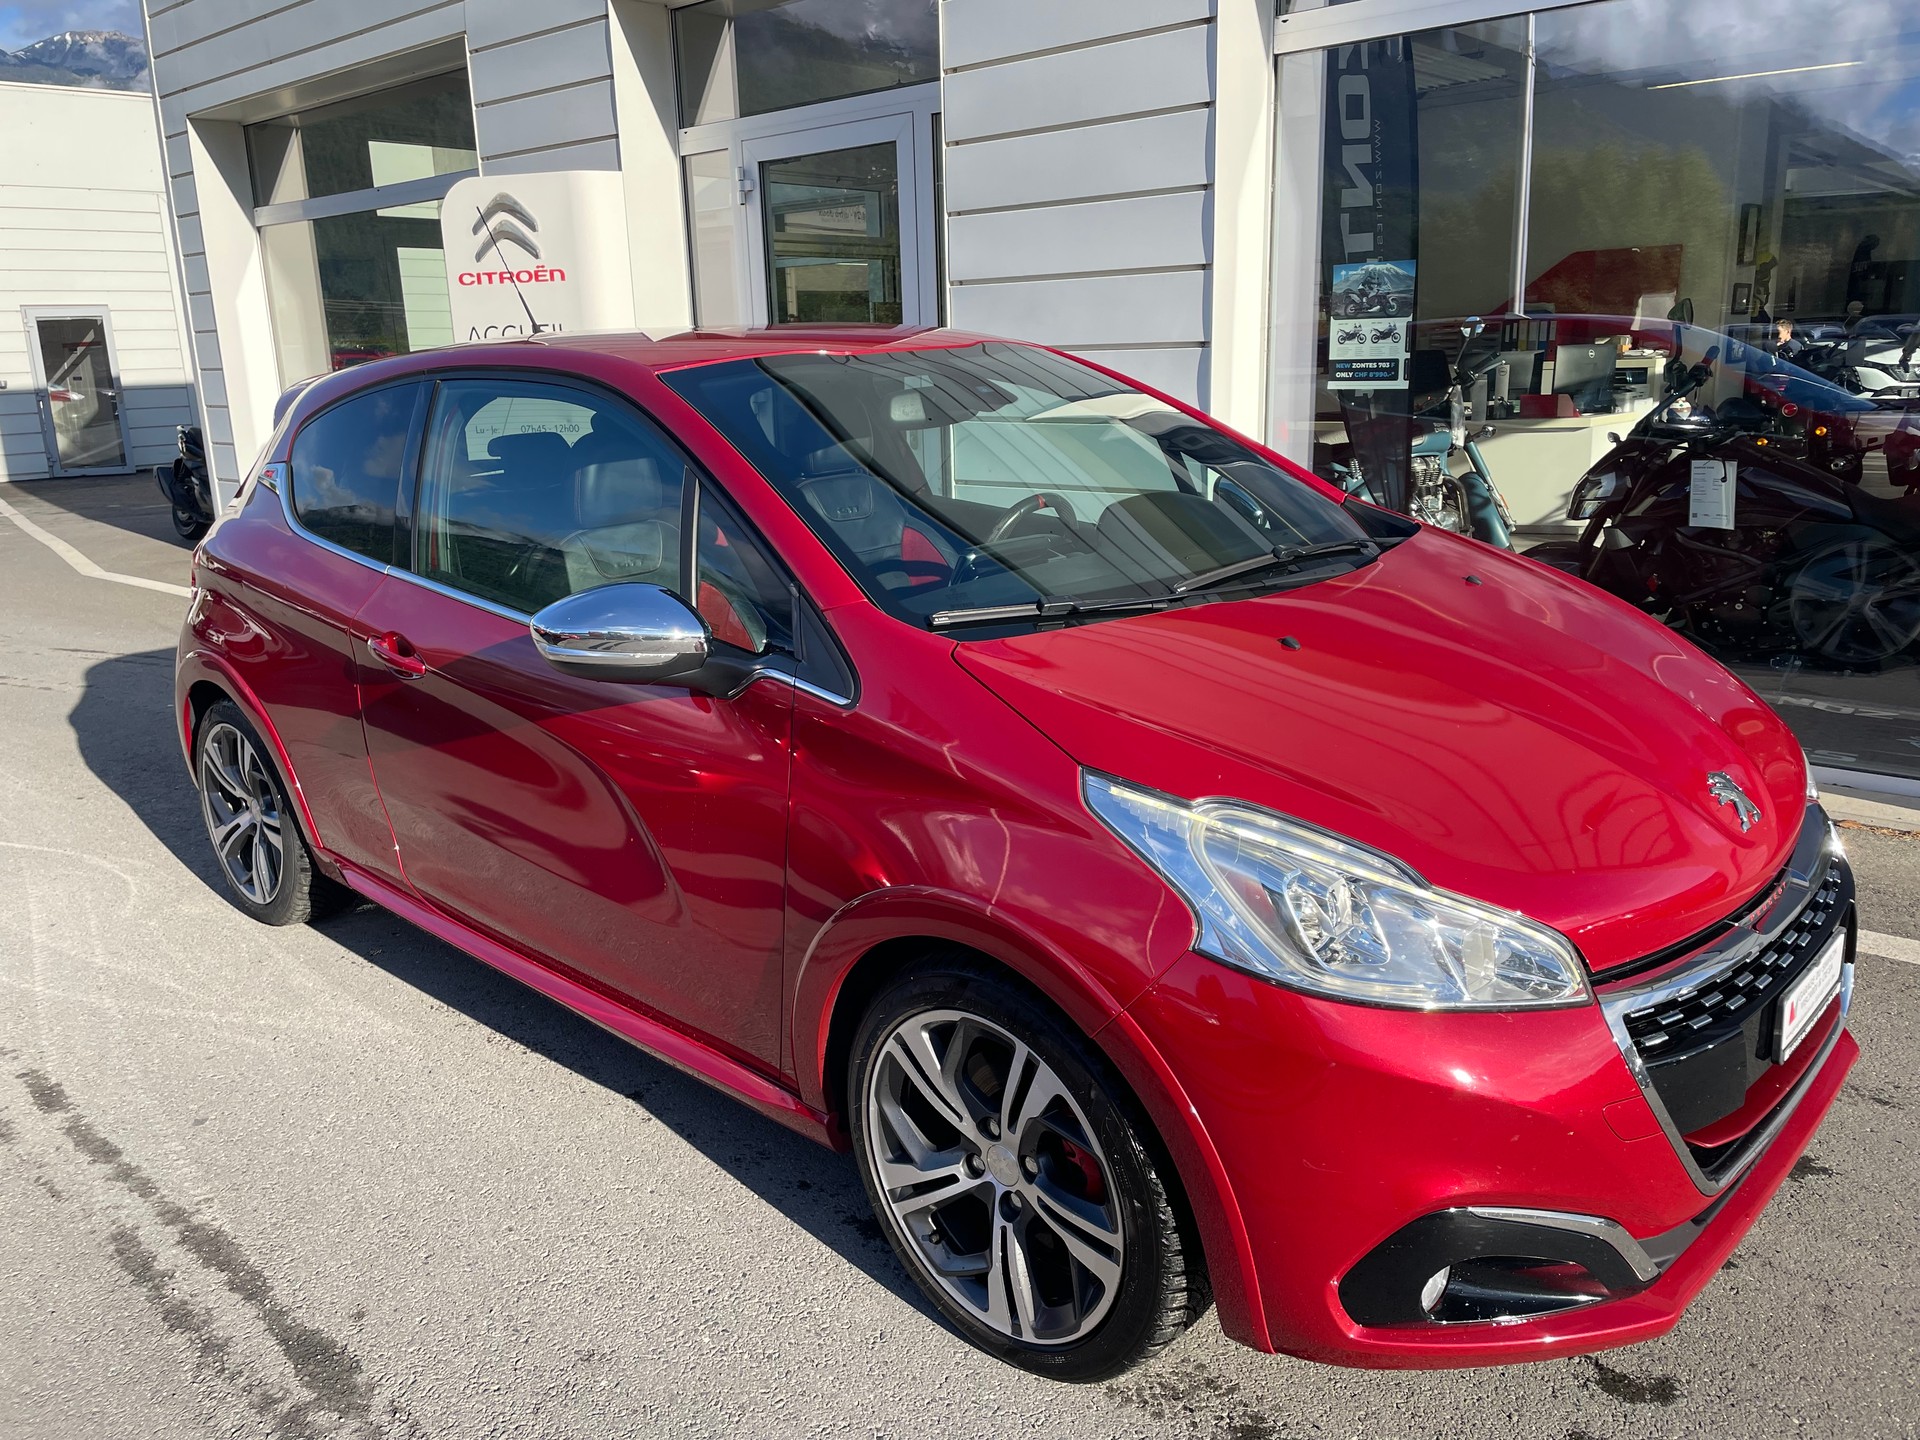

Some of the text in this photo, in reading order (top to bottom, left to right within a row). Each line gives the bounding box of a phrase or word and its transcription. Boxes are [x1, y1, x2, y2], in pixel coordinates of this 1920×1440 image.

[458, 264, 566, 286] CITROËN
[475, 426, 485, 434] Lu
[520, 424, 547, 433] 07h45
[554, 424, 580, 433] 12h00
